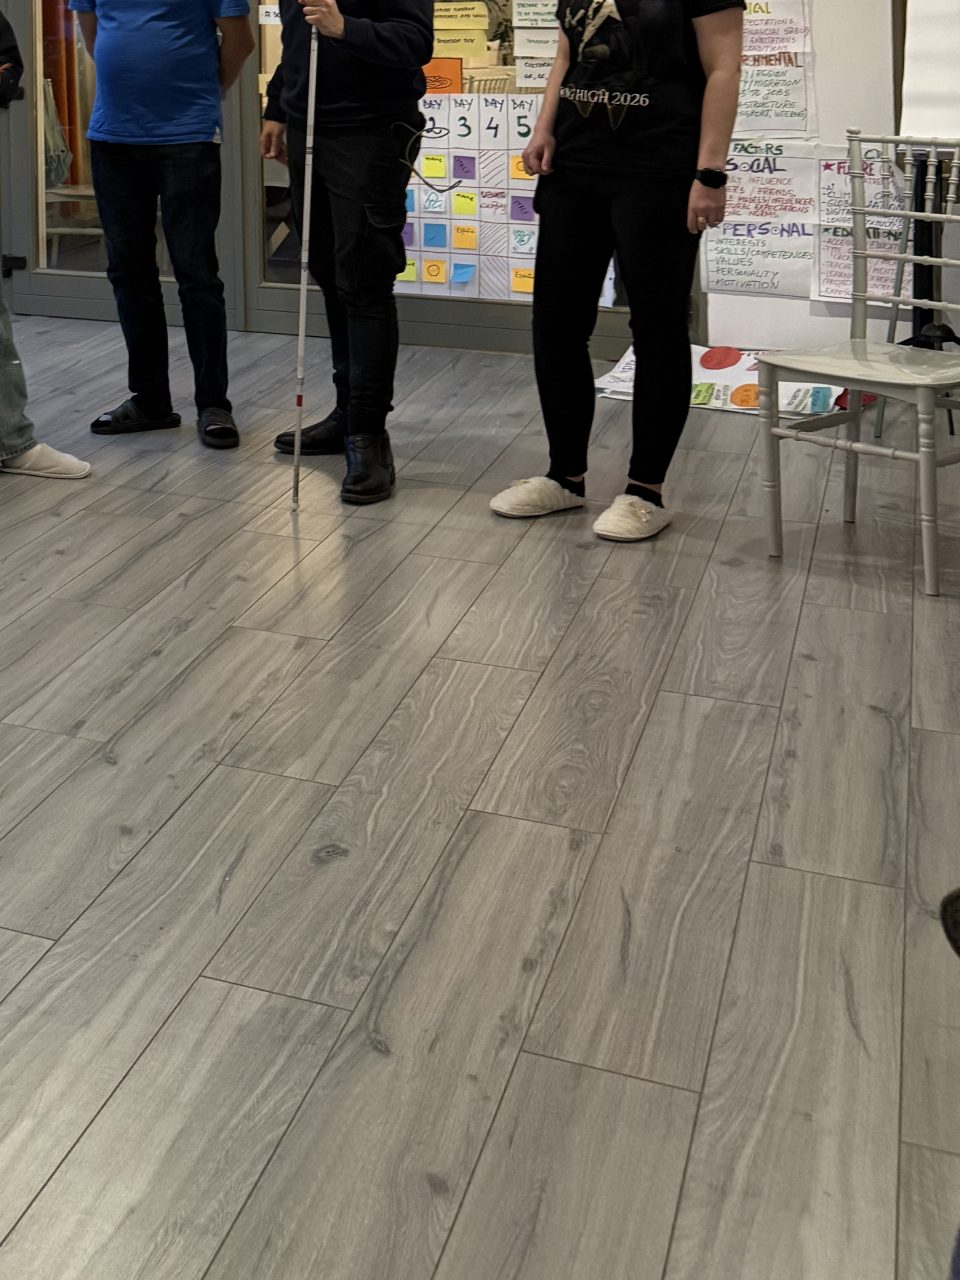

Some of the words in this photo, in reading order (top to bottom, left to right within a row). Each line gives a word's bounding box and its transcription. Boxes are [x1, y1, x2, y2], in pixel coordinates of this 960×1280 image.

[423, 98, 442, 110] DAY
[454, 98, 474, 112] DAY
[484, 98, 504, 112] DAY
[511, 99, 534, 112] DAY
[611, 92, 650, 106] 2026
[457, 116, 472, 137] 3
[486, 116, 499, 138] 4
[516, 115, 532, 138] 5
[732, 143, 784, 156] FACTORS
[722, 222, 814, 238] PERSONAL
